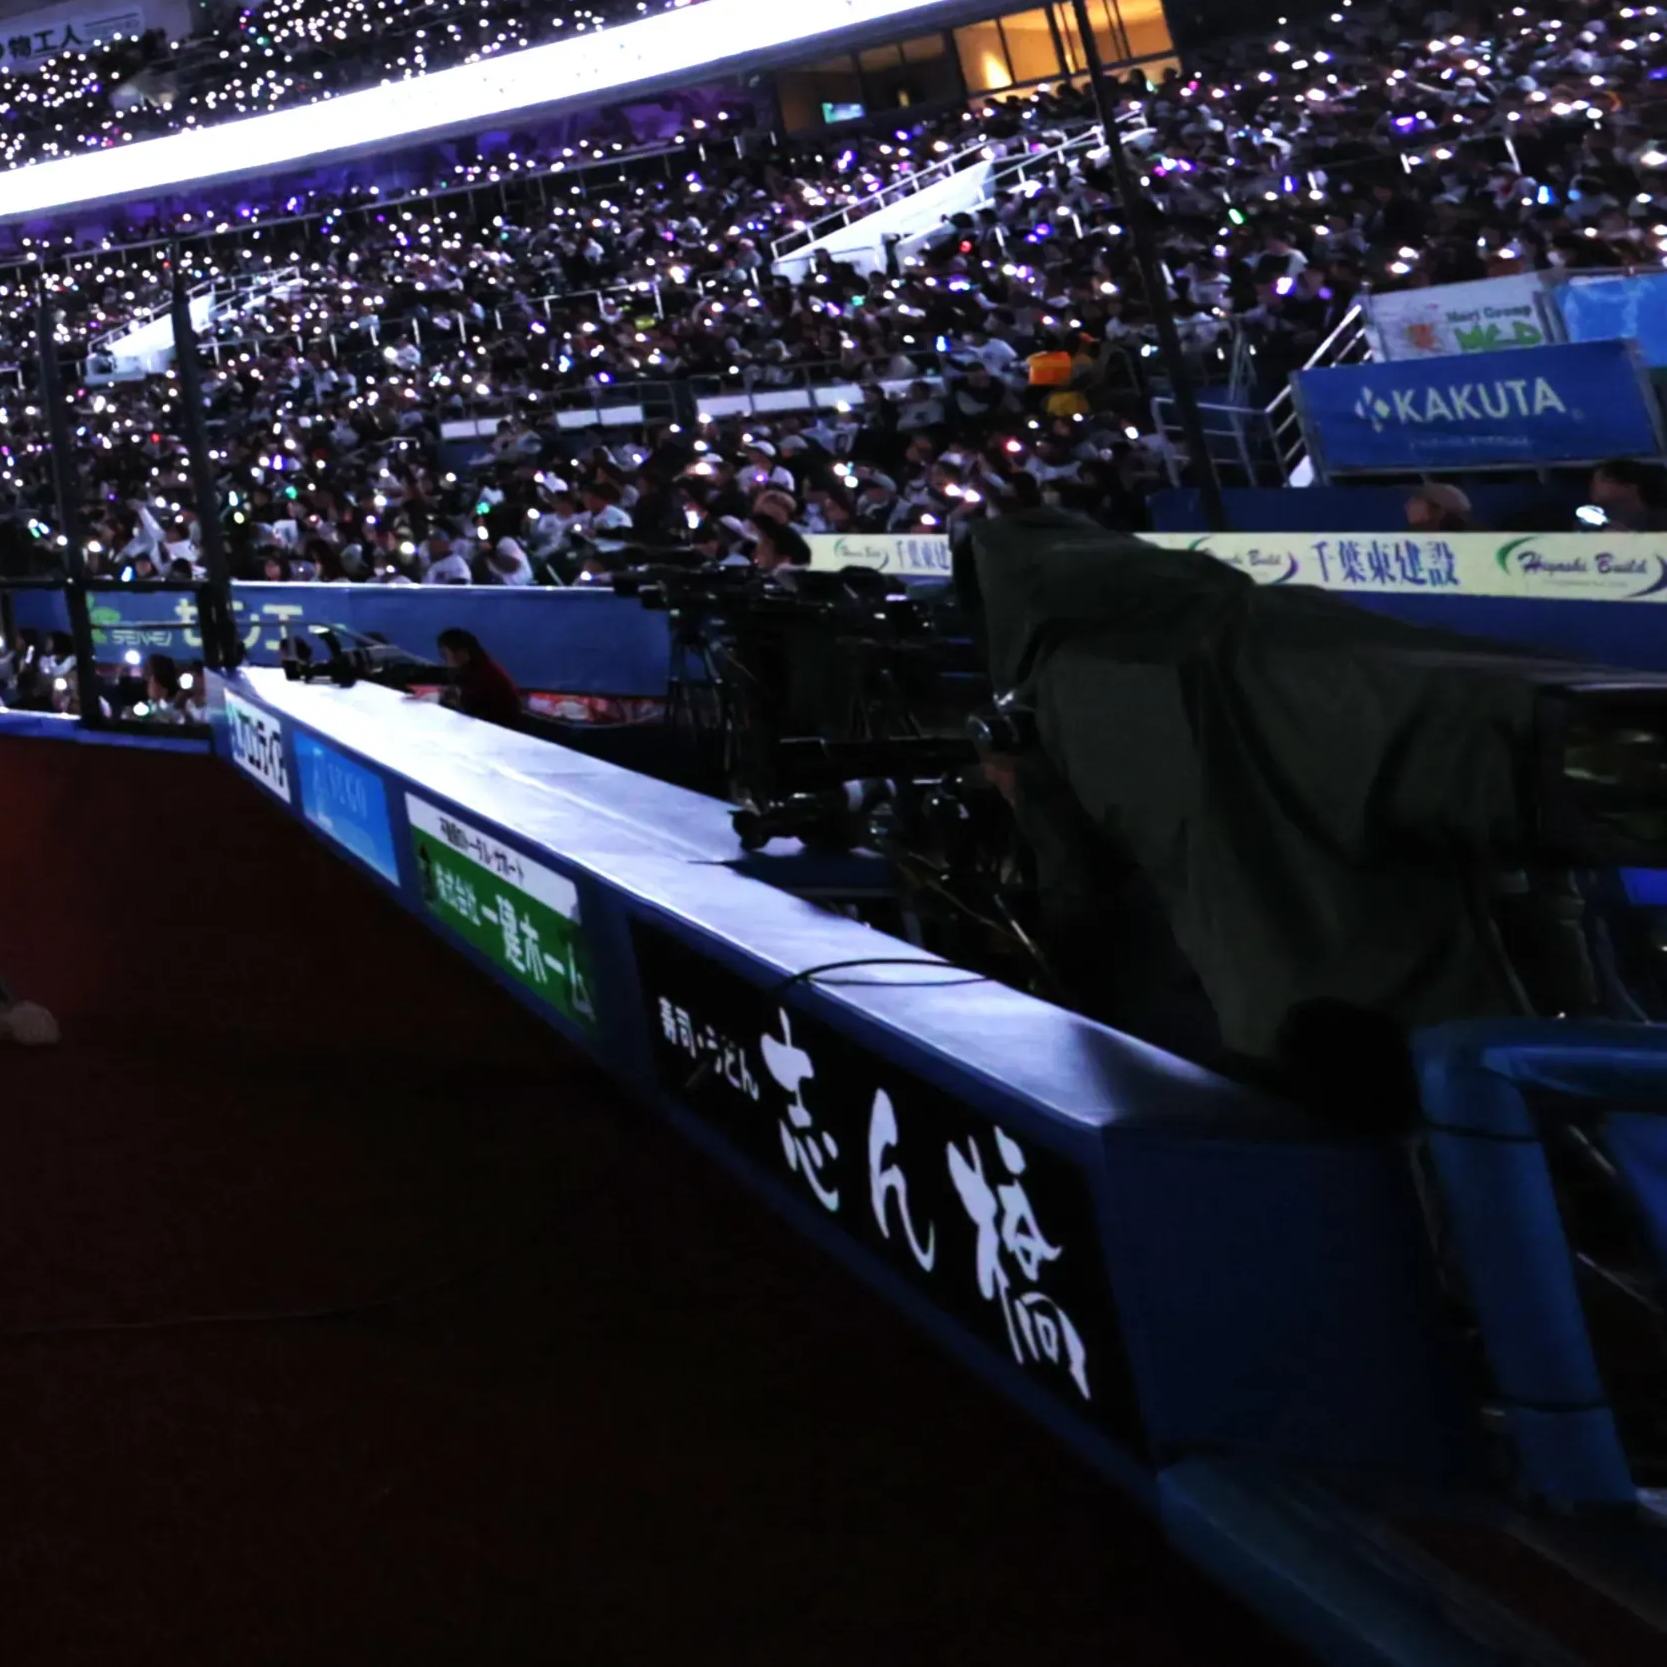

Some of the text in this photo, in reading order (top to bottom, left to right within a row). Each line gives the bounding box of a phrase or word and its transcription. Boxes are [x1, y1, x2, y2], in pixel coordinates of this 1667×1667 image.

[1392, 377, 1566, 425] KAKUTA
[1310, 538, 1460, 588] 千葉東建設
[1594, 551, 1649, 574] Build
[760, 1005, 1093, 1402] 志ん橋
